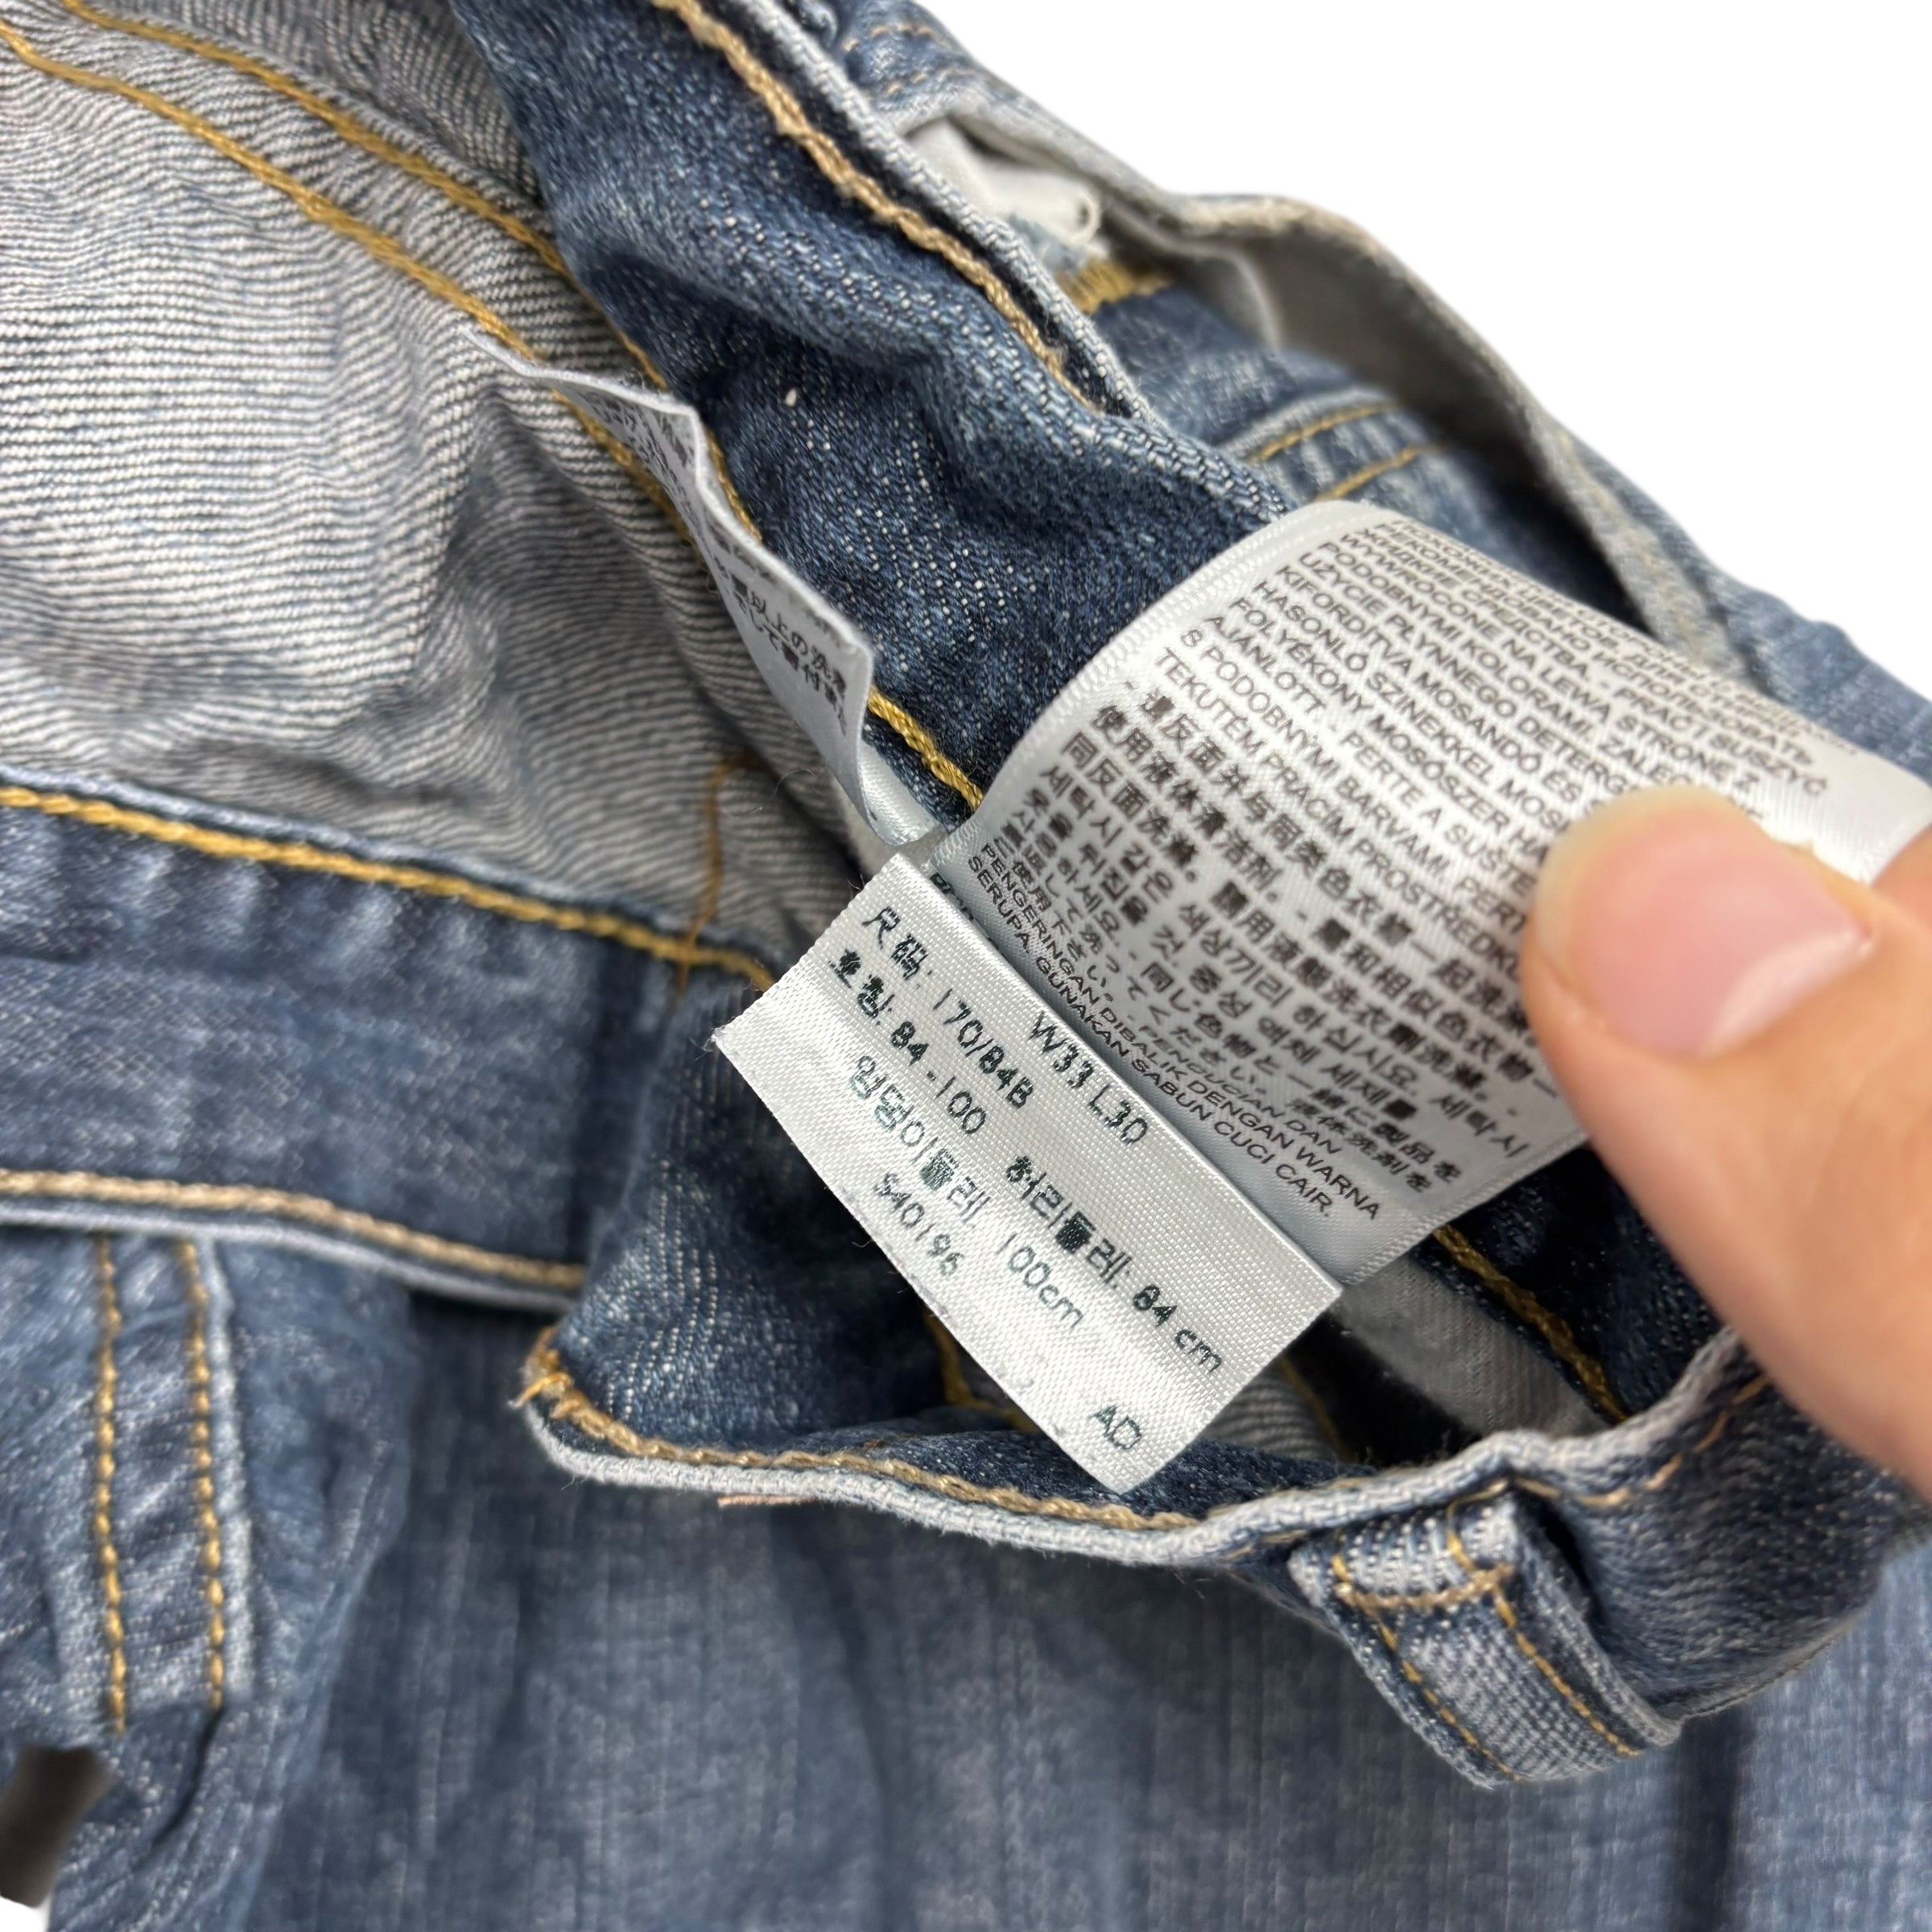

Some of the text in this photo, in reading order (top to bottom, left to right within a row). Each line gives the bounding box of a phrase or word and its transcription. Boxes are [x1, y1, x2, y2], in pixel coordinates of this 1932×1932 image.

[1318, 542, 1463, 642] PODOBNYMI
[1501, 638, 1537, 671] NA
[1340, 729, 1425, 807] PERTE
[1420, 807, 1442, 828] A
[1516, 715, 1628, 793] DETERG
[1542, 770, 1583, 803] ÉS
[933, 989, 1033, 1108] 170/84B
[968, 855, 1030, 955] SERUPA.
[1031, 958, 1129, 1061] GUNAKAN
[1131, 1058, 1212, 1121] SABUN
[1213, 1120, 1276, 1166] CUCI
[1274, 1162, 1334, 1218] CAIR.
[981, 844, 1100, 1005] PENGERINGAN
[1100, 1007, 1187, 1080] DIBALIK
[1187, 1080, 1294, 1150] DENGAN
[1296, 1146, 1380, 1220] WARNA
[1029, 1012, 1148, 1144] W33 L30
[1285, 1120, 1342, 1154] DAN
[1322, 1064, 1418, 1121] 세제
[873, 1173, 1143, 1452] S40196 AD
[996, 1233, 1084, 1329] 100cm
[1133, 1284, 1177, 1327] 84
[1174, 1329, 1223, 1374] cm
